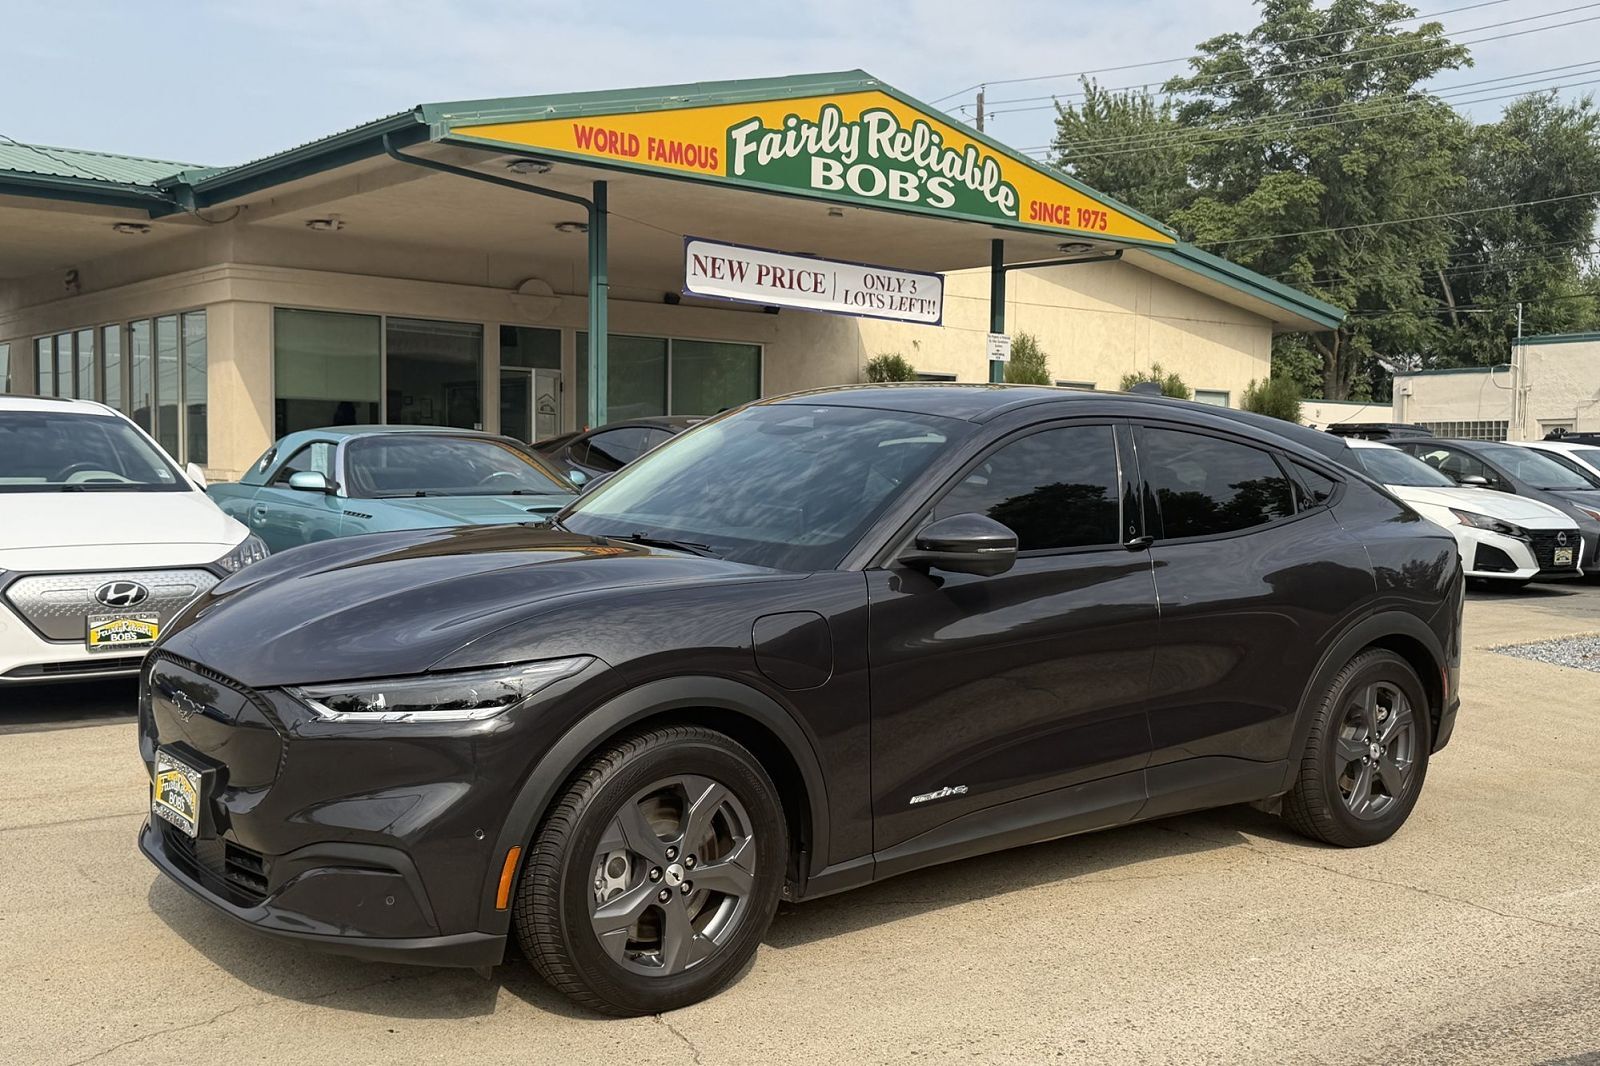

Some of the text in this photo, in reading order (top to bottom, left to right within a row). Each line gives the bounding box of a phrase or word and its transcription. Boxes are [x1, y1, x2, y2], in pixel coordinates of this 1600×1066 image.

[573, 123, 718, 171] WORLD FAMOUS
[731, 105, 1017, 217] Fairly Reliable
[810, 156, 956, 208] BOB'S
[1029, 200, 1108, 231] SINCE 1975
[691, 253, 827, 294] NEW PRICE
[863, 273, 917, 295] ONLY 3
[843, 289, 936, 315] LOTS LEFT!!
